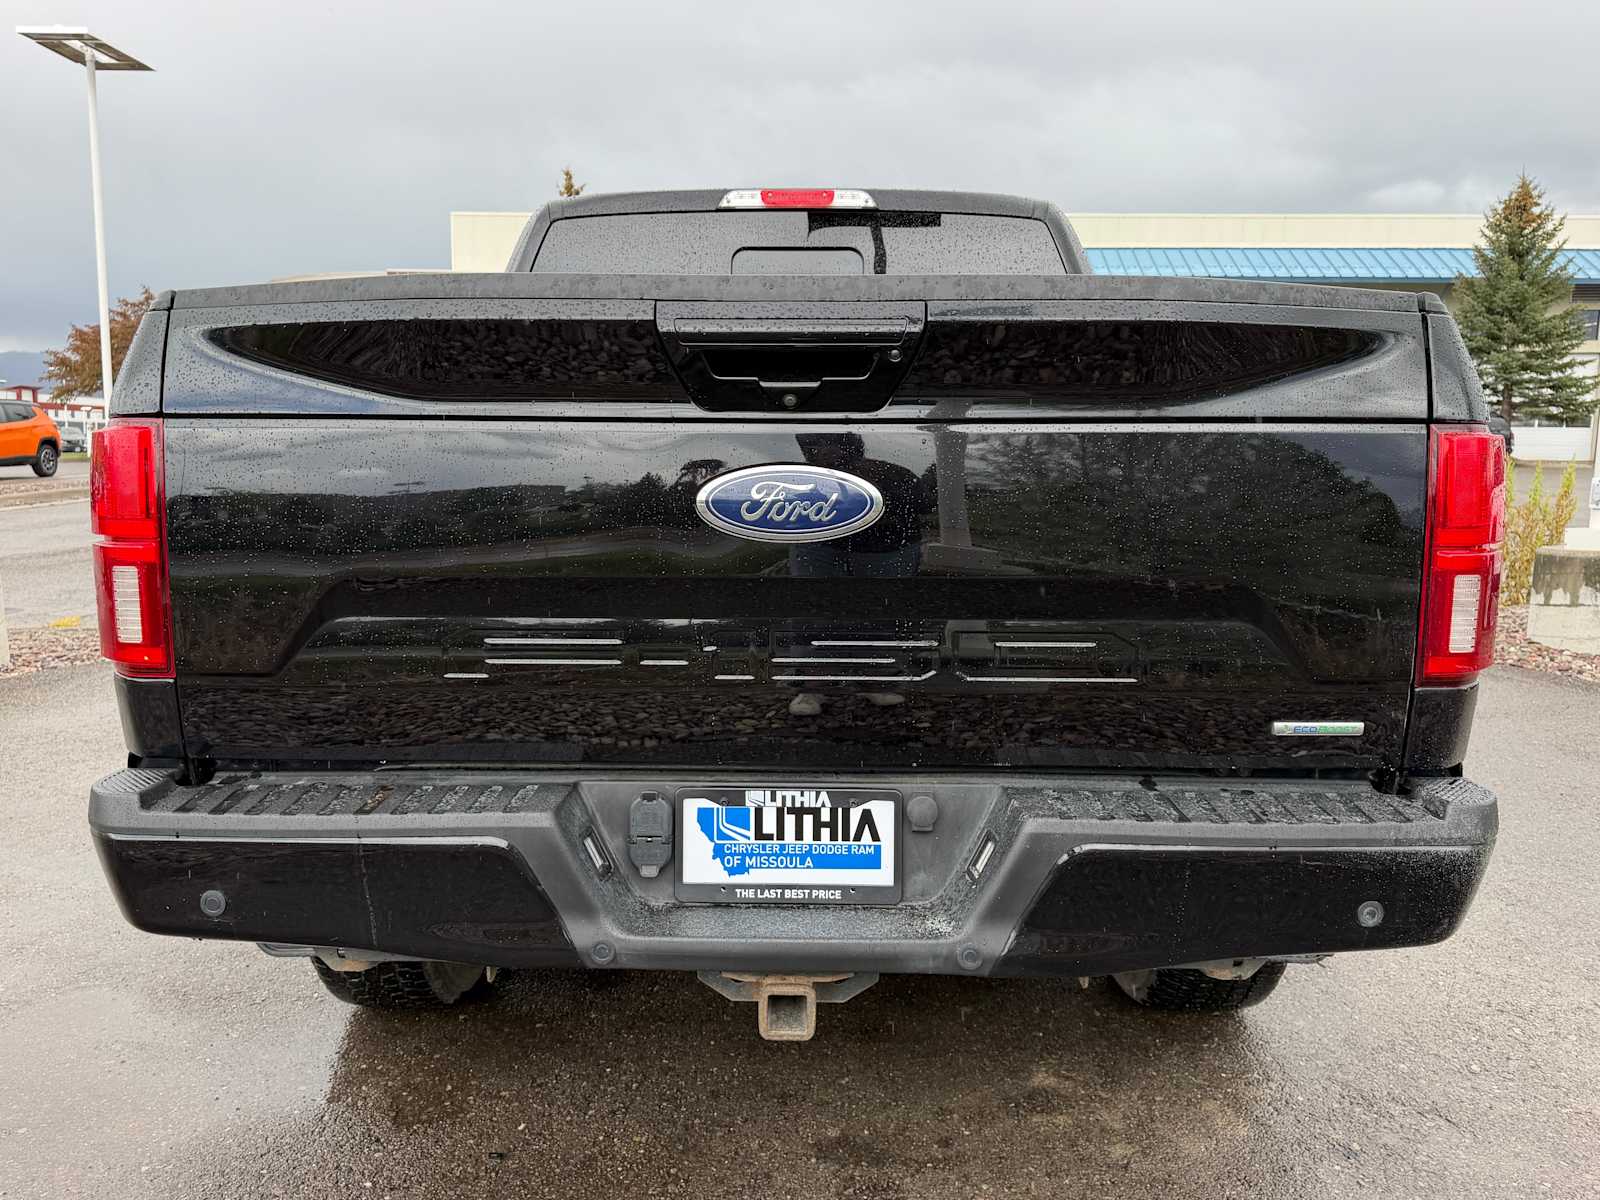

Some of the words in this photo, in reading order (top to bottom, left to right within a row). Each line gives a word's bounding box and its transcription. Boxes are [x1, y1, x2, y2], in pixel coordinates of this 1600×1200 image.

[741, 481, 838, 522] Ford
[766, 790, 832, 807] LITHIA
[754, 807, 881, 842] LITHIA
[724, 843, 780, 854] CHRYSLER
[782, 844, 809, 854] JEEP
[812, 844, 849, 855] DODGE
[851, 845, 875, 855] RAM
[724, 855, 741, 867] OF
[745, 856, 814, 868] MISSOULA
[735, 888, 756, 898] THE
[757, 889, 783, 899] LAST
[784, 889, 810, 899] BEST
[812, 889, 842, 900] PRICE
